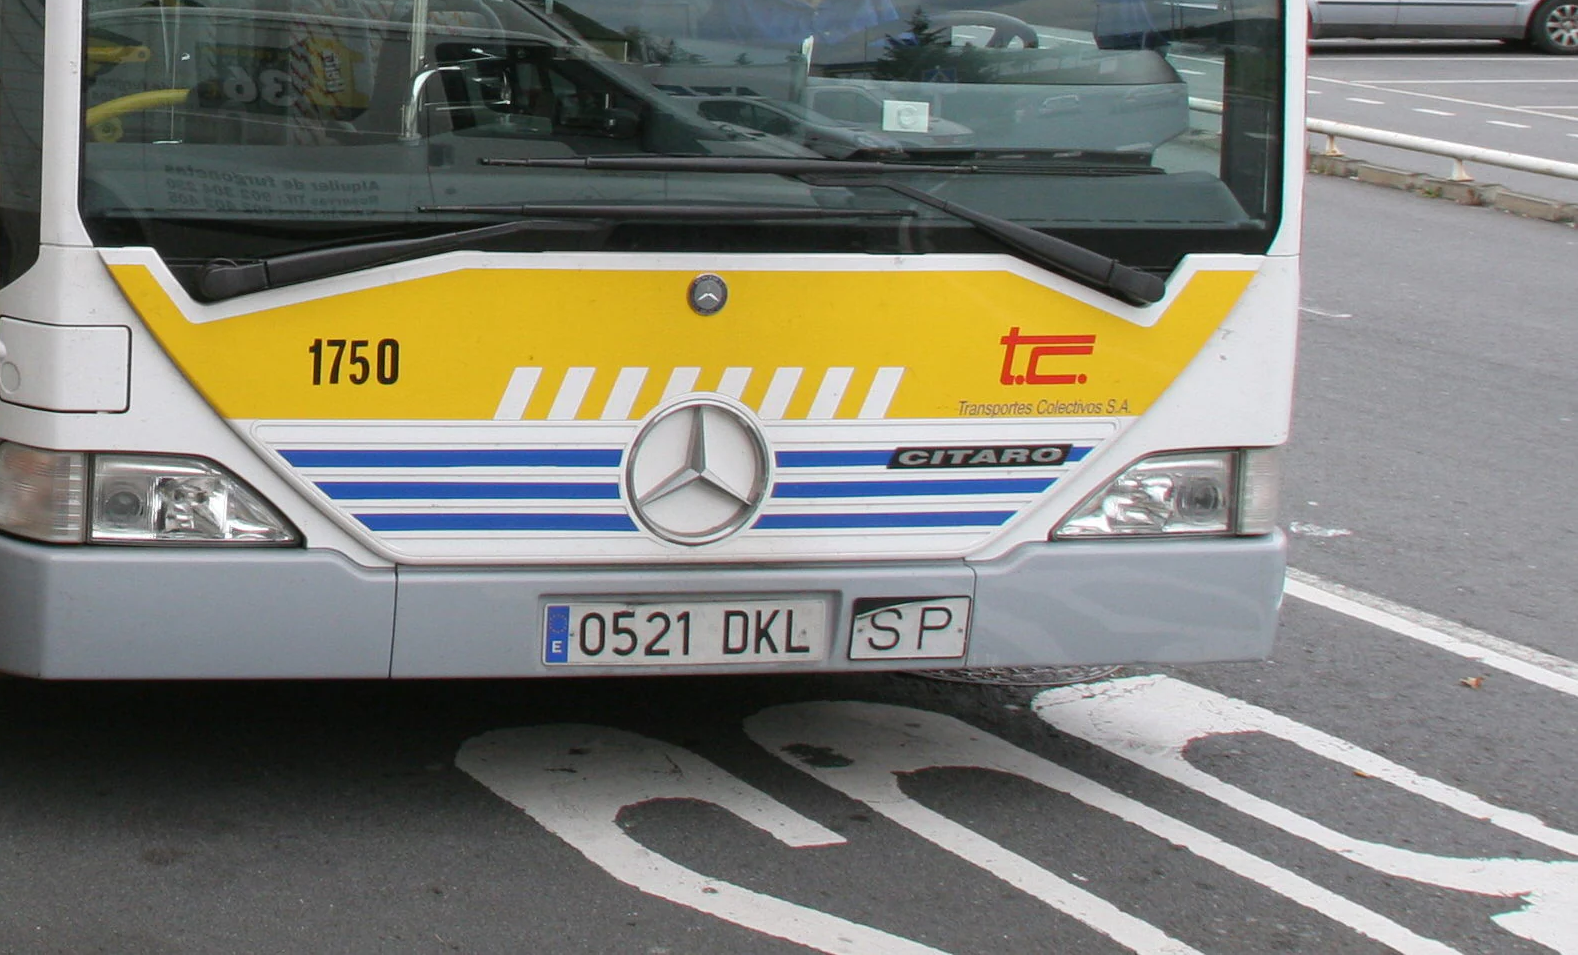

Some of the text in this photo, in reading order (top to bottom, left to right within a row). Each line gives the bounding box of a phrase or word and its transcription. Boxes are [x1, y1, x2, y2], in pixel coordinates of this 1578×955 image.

[308, 337, 400, 386] 1750
[957, 398, 1131, 418] Transportes Colectivos S.A.
[897, 446, 1064, 466] CITARO
[551, 608, 811, 657] E 0521 DKL
